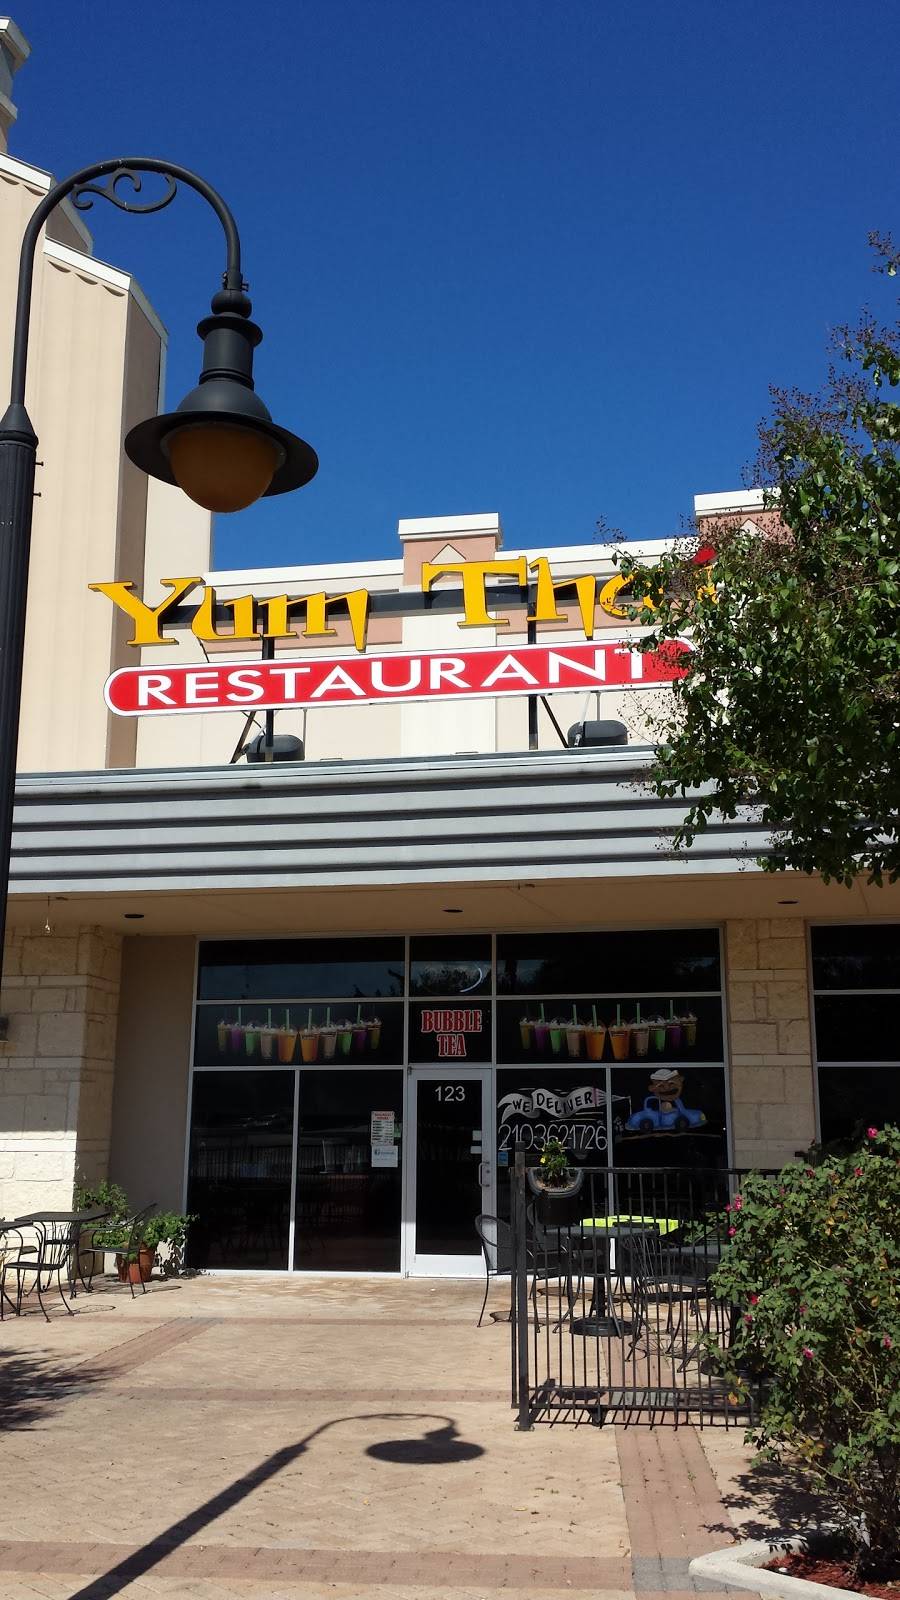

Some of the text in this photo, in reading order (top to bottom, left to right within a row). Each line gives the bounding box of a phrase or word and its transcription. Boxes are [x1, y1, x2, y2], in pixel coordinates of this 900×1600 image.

[88, 576, 370, 651] Yum
[136, 648, 644, 707] RESTAURANT
[421, 1009, 482, 1032] BUBBLE
[436, 1033, 467, 1057] TEA
[434, 1085, 466, 1102] 123
[512, 1091, 593, 1114] WE DELIVER
